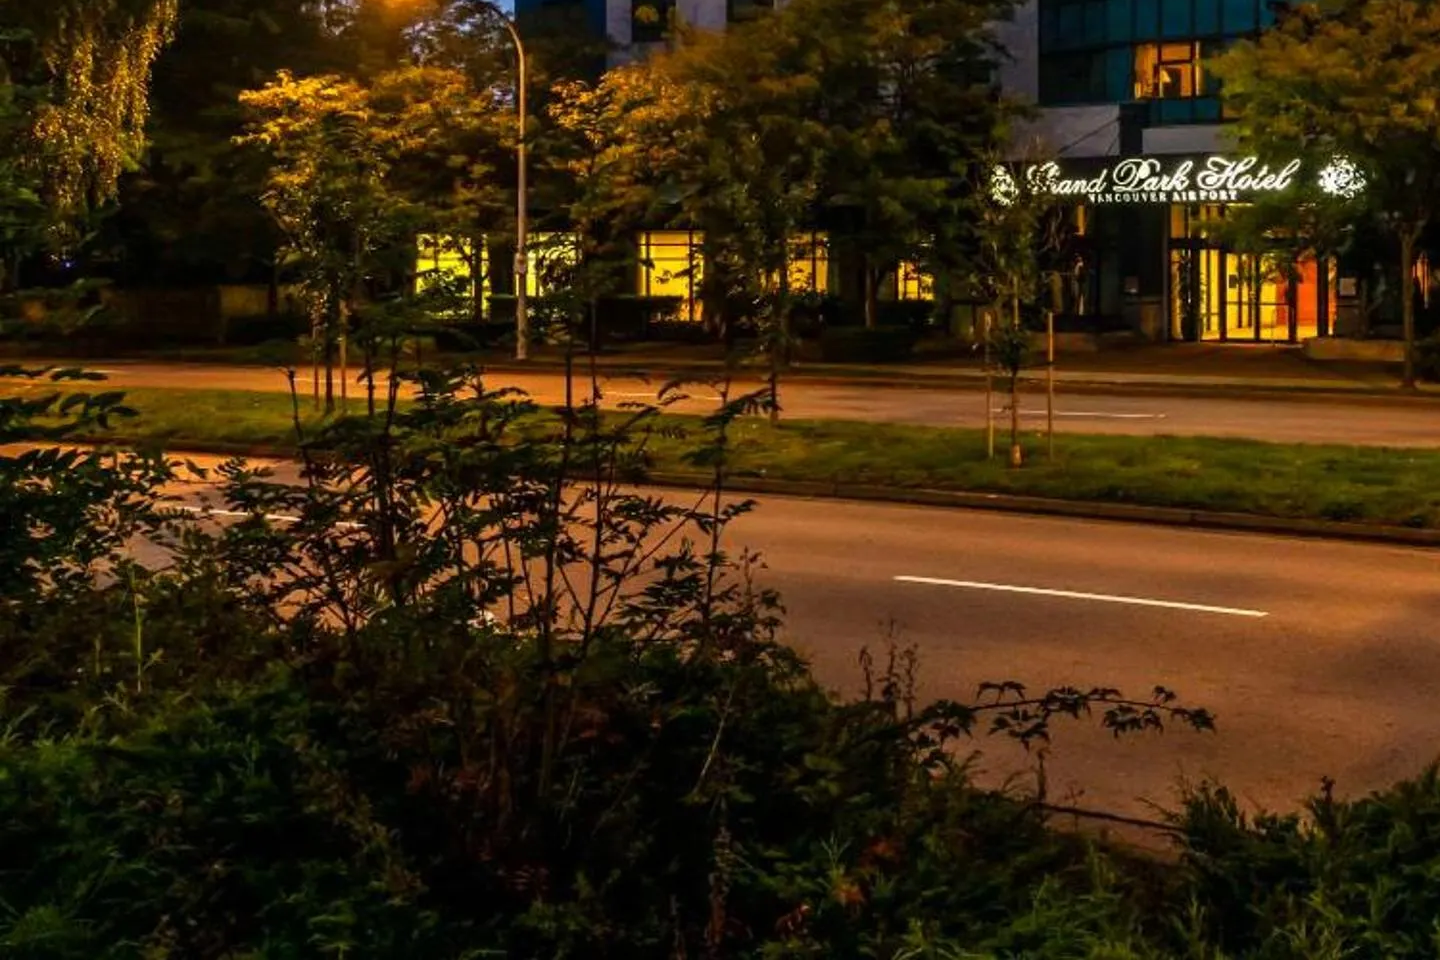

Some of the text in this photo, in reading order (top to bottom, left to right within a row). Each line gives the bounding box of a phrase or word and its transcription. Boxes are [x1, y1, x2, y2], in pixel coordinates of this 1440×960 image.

[1112, 158, 1193, 192] Park
[1197, 156, 1301, 191] Hotel
[1087, 190, 1239, 203] VANCOUVER AIRPORT
